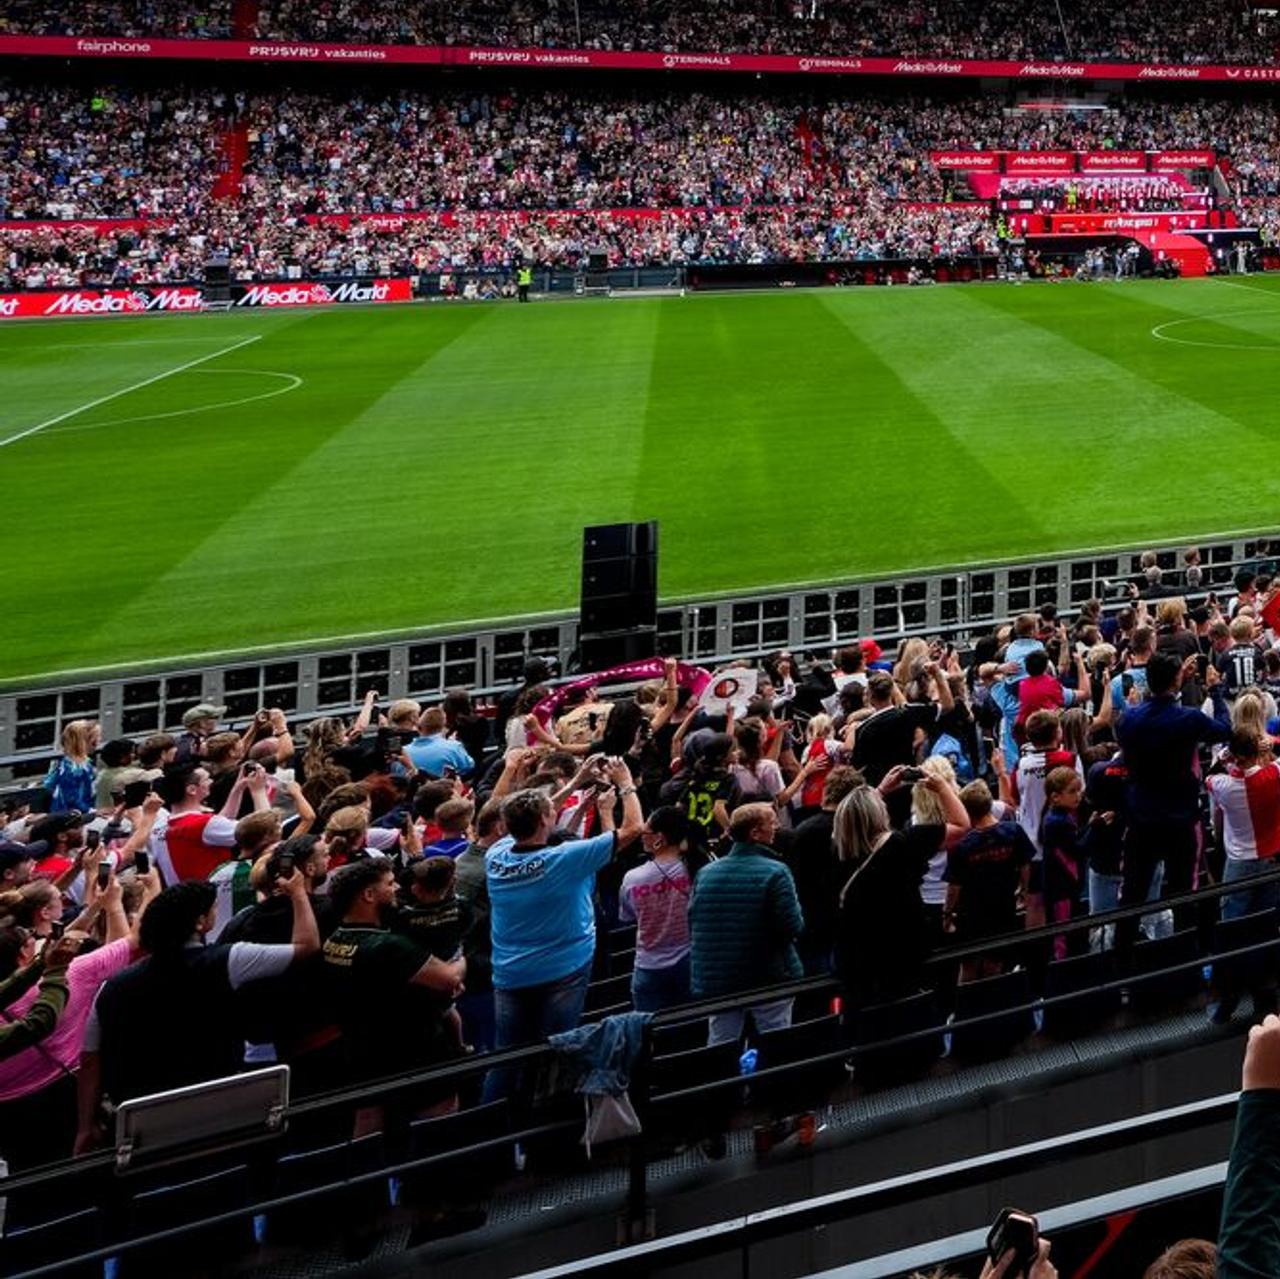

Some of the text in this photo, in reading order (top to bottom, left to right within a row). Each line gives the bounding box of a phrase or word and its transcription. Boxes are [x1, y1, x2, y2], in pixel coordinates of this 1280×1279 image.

[78, 40, 150, 54] fairphone
[324, 48, 386, 59] vakanties
[535, 53, 589, 63] vakanties
[45, 292, 127, 314] Media
[237, 282, 390, 306] Media Markt
[1232, 655, 1255, 687] 10
